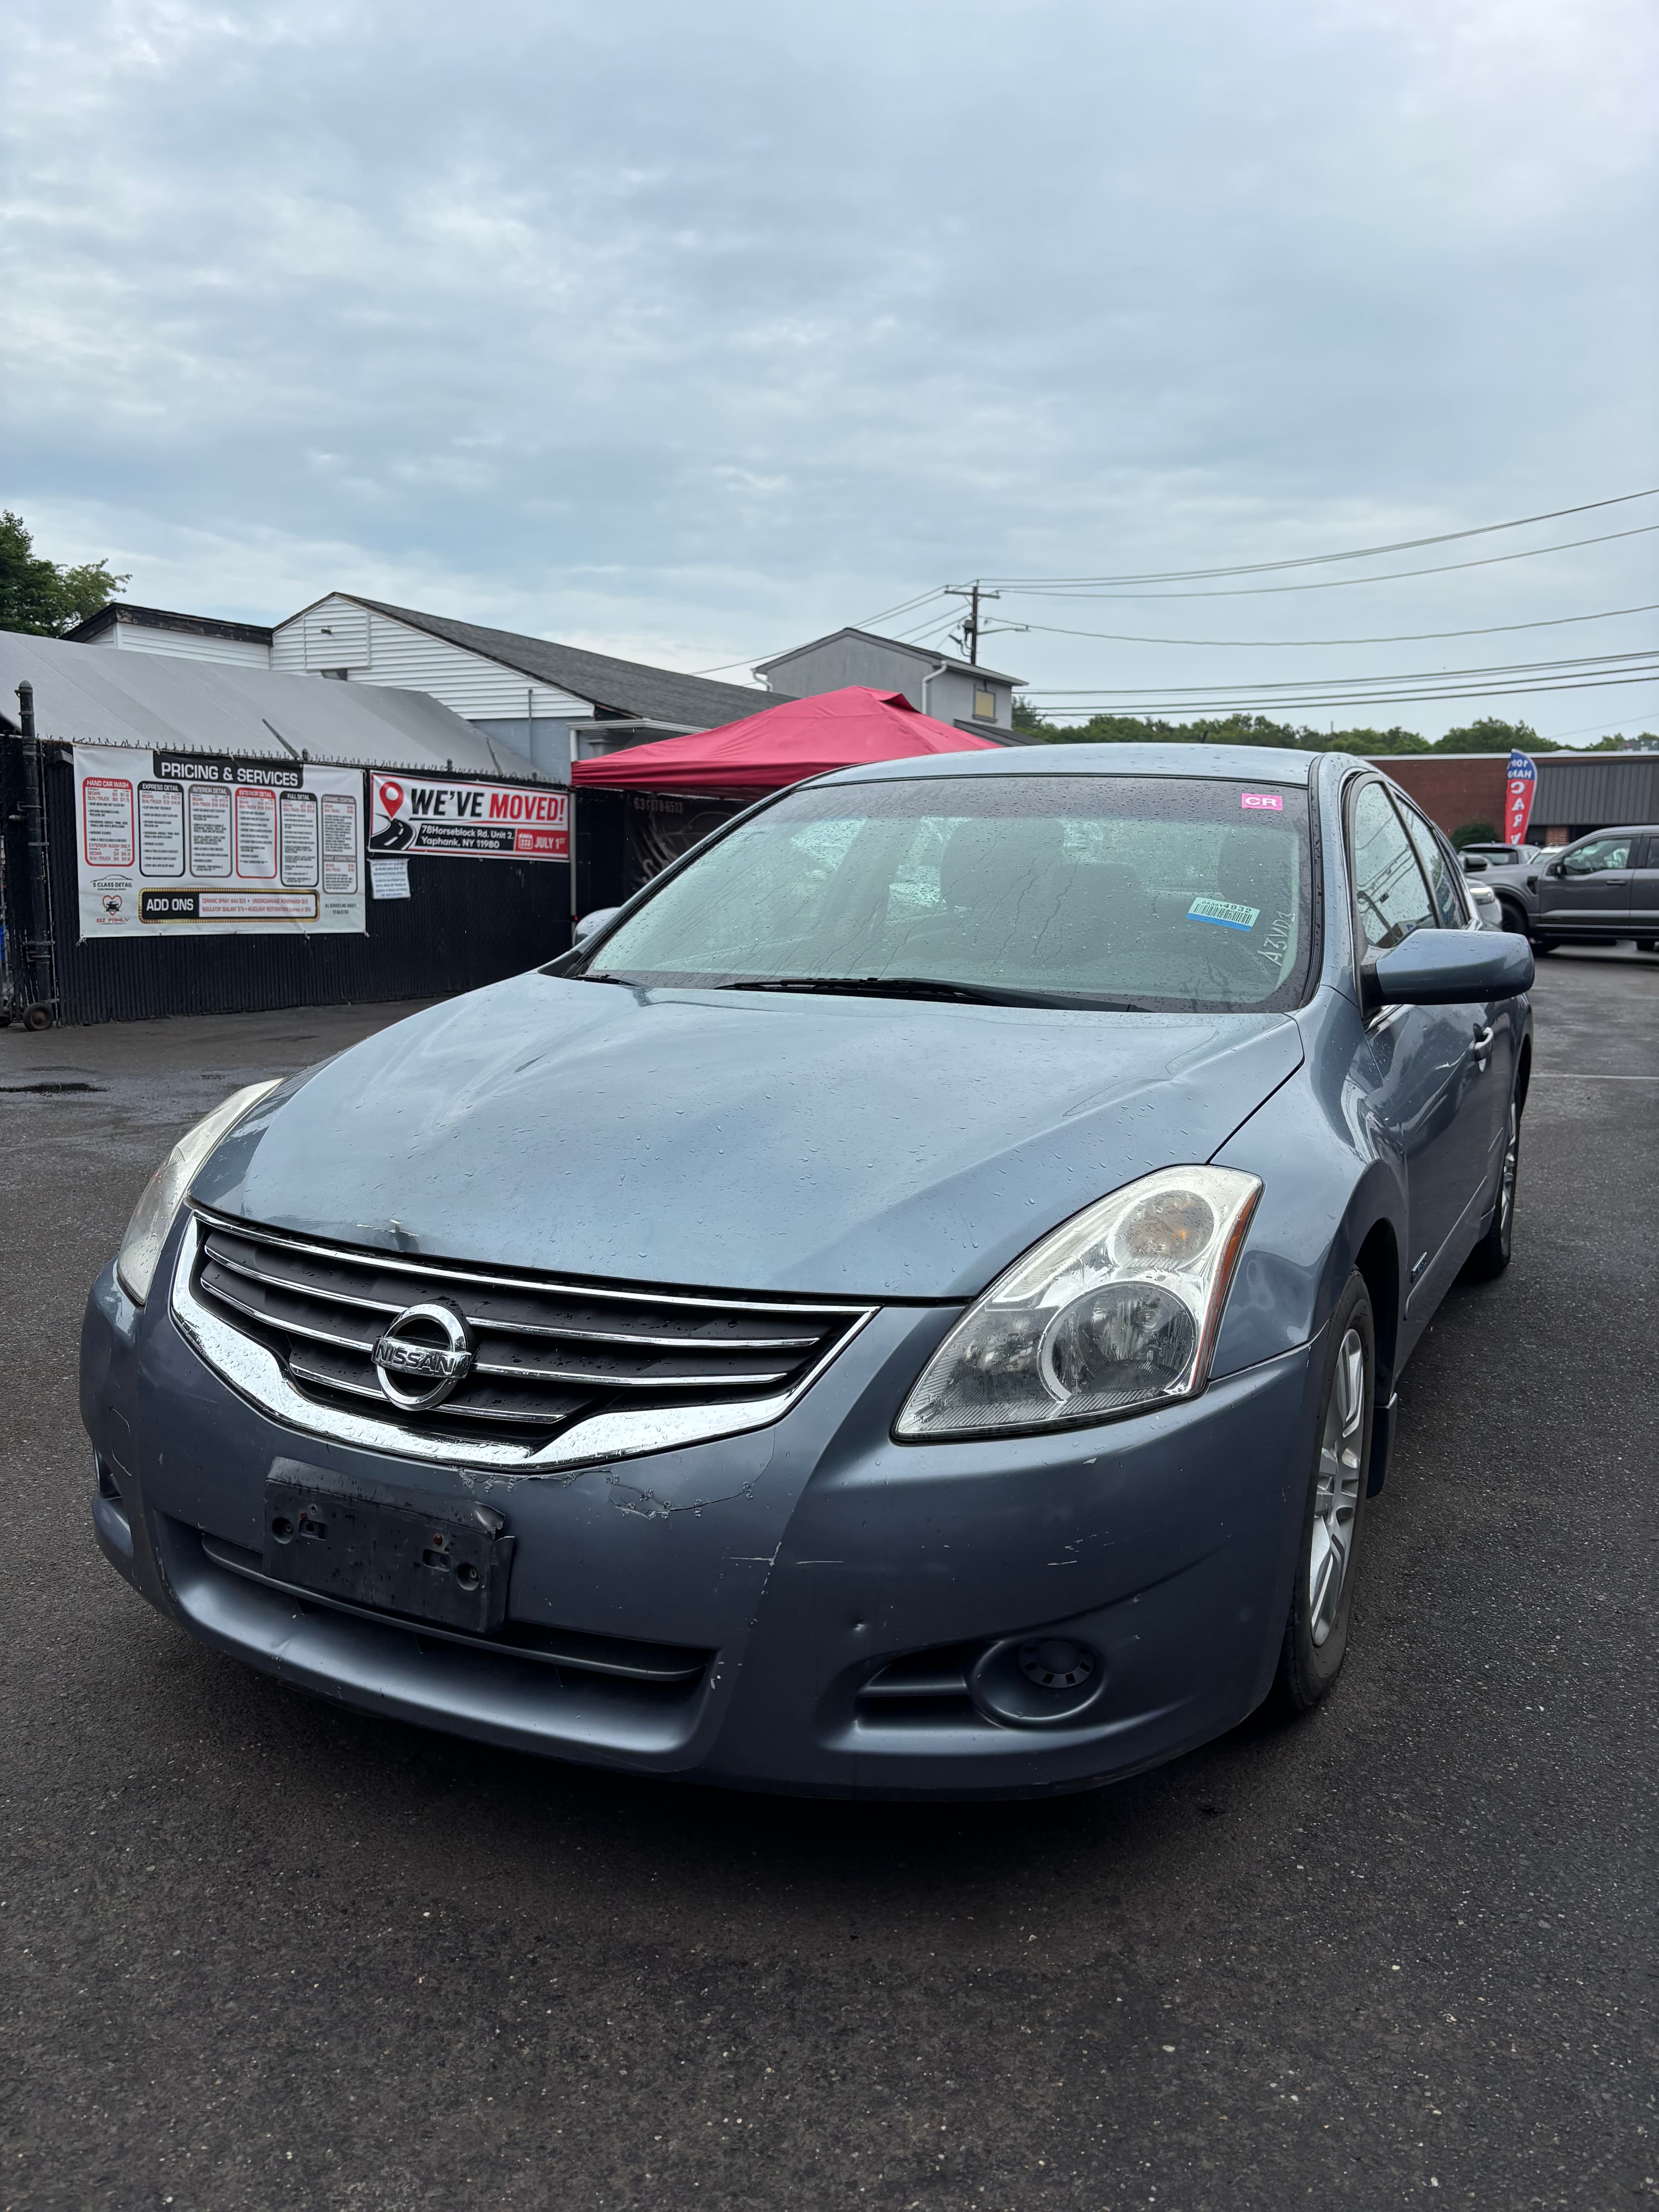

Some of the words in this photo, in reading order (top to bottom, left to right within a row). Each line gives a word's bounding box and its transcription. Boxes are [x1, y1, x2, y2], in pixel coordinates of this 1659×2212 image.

[161, 762, 218, 780] PRICING
[223, 767, 233, 781] &
[237, 768, 298, 786] SERVICES
[411, 788, 484, 817] WE'VE
[489, 793, 566, 822] MOVED!
[1245, 797, 1277, 807] CR
[477, 830, 489, 839] Rd.
[491, 830, 506, 839] Unit
[421, 836, 461, 847] Yaphank,
[462, 838, 475, 848] NY
[476, 839, 500, 849] 11980
[534, 836, 554, 849] JULY
[146, 899, 169, 911] ADD
[172, 899, 194, 911] ONS
[376, 1343, 456, 1375] NISSAN
